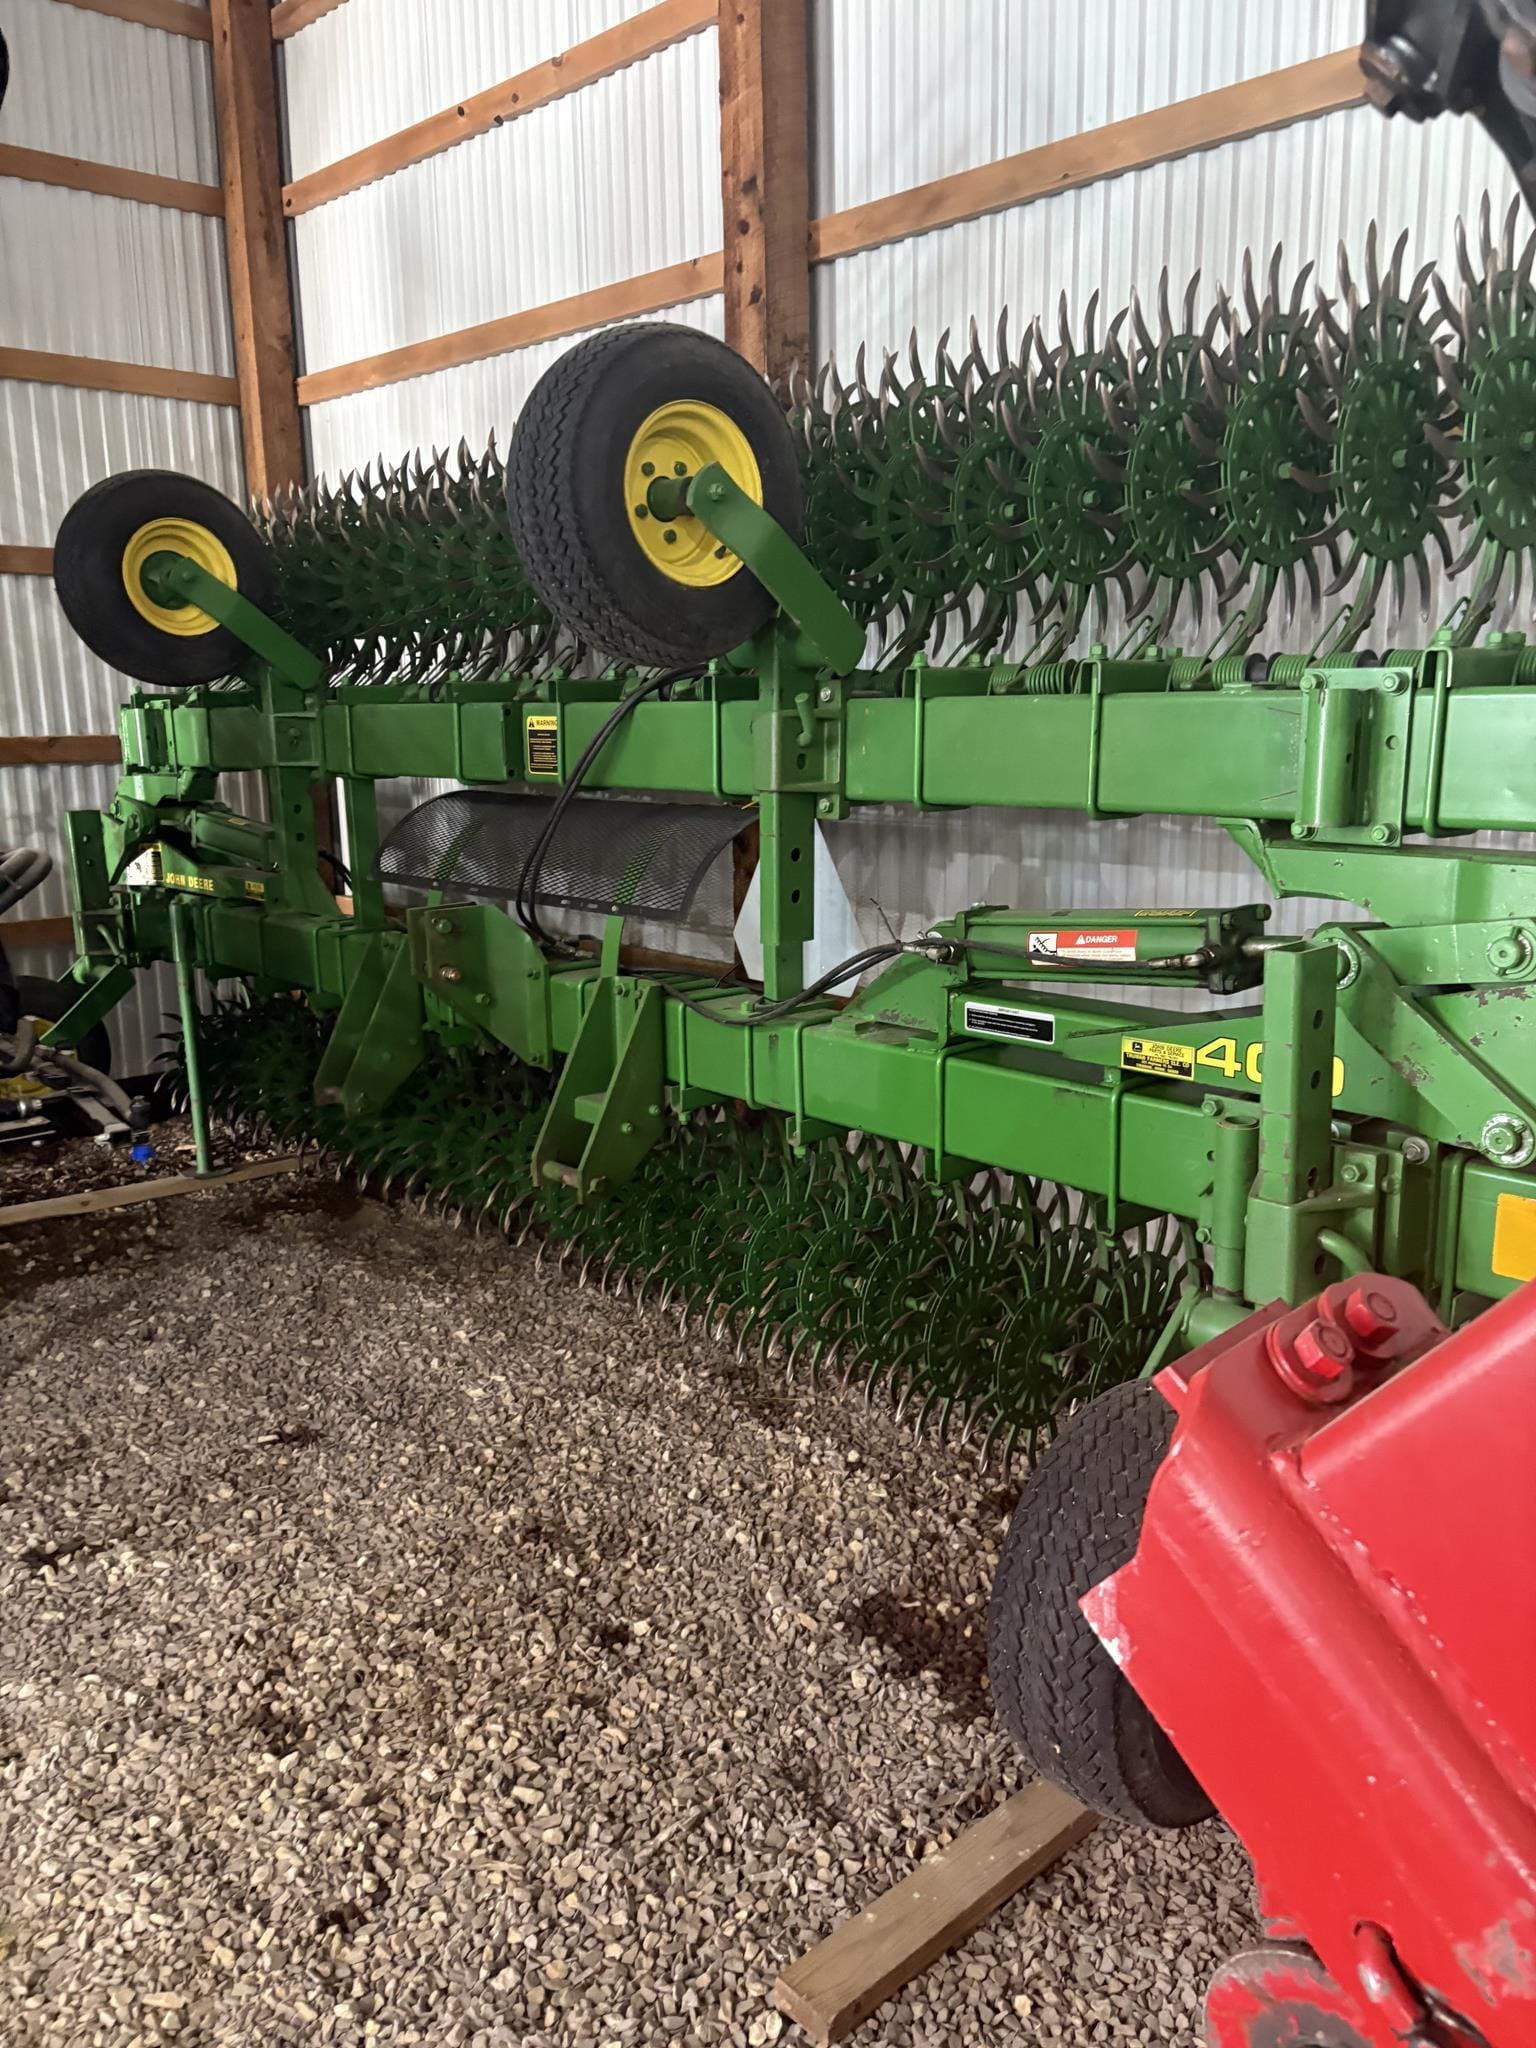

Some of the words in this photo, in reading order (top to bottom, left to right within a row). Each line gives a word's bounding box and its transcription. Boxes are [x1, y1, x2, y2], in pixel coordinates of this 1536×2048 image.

[166, 872, 185, 885] JOHN
[187, 875, 215, 891] DEERE
[1085, 935, 1118, 944] DANGER
